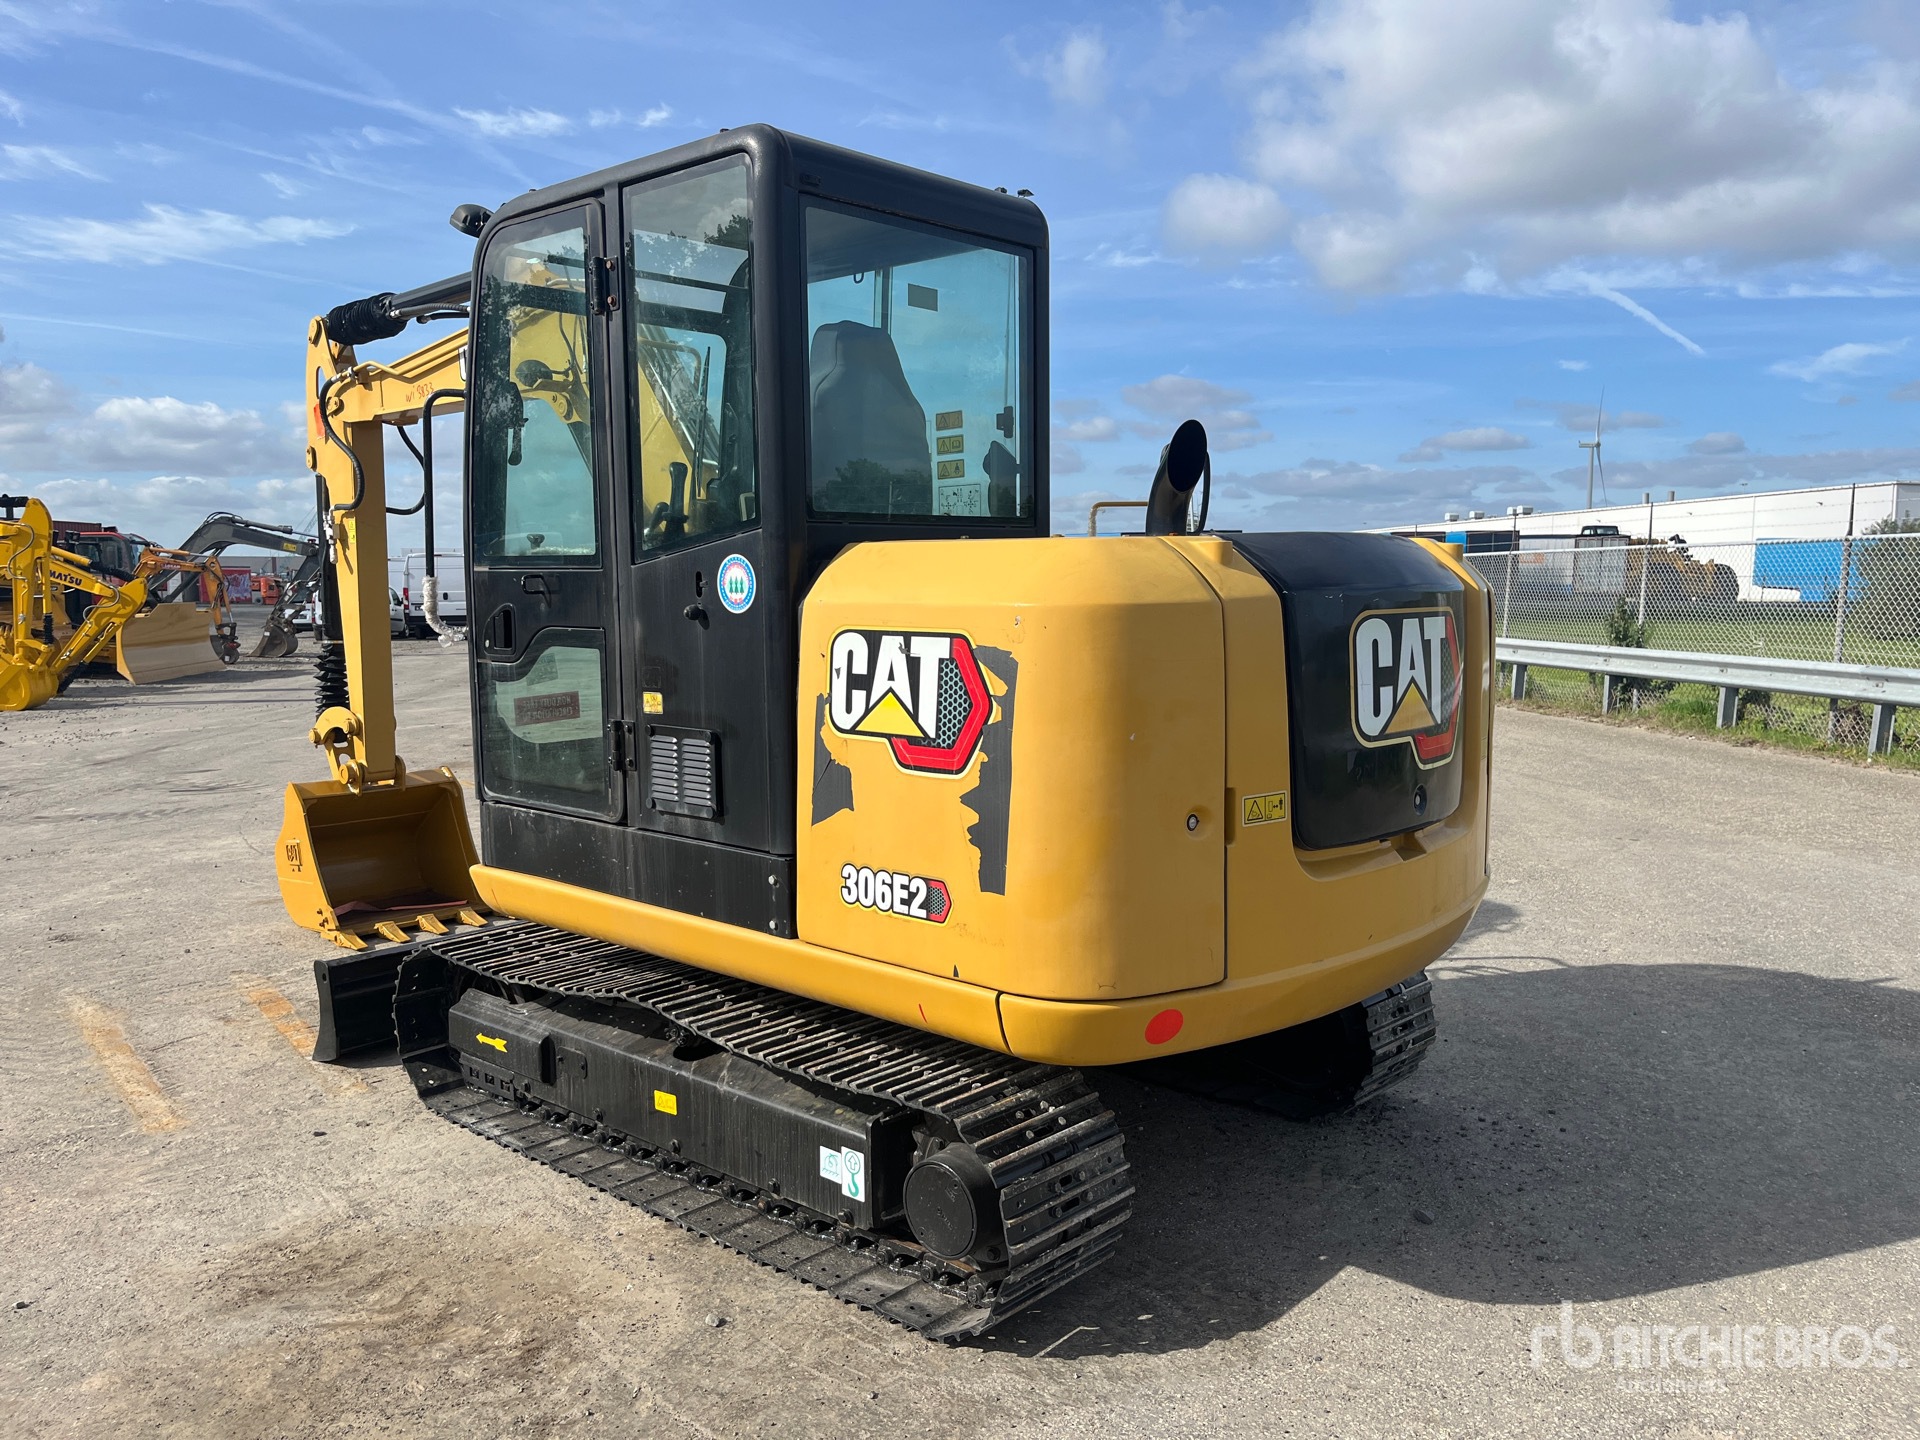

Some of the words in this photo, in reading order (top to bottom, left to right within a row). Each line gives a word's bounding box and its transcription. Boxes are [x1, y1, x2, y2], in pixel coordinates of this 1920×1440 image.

[831, 632, 950, 738] CAT
[1356, 616, 1446, 736] CAT
[841, 863, 927, 919] 306E2
